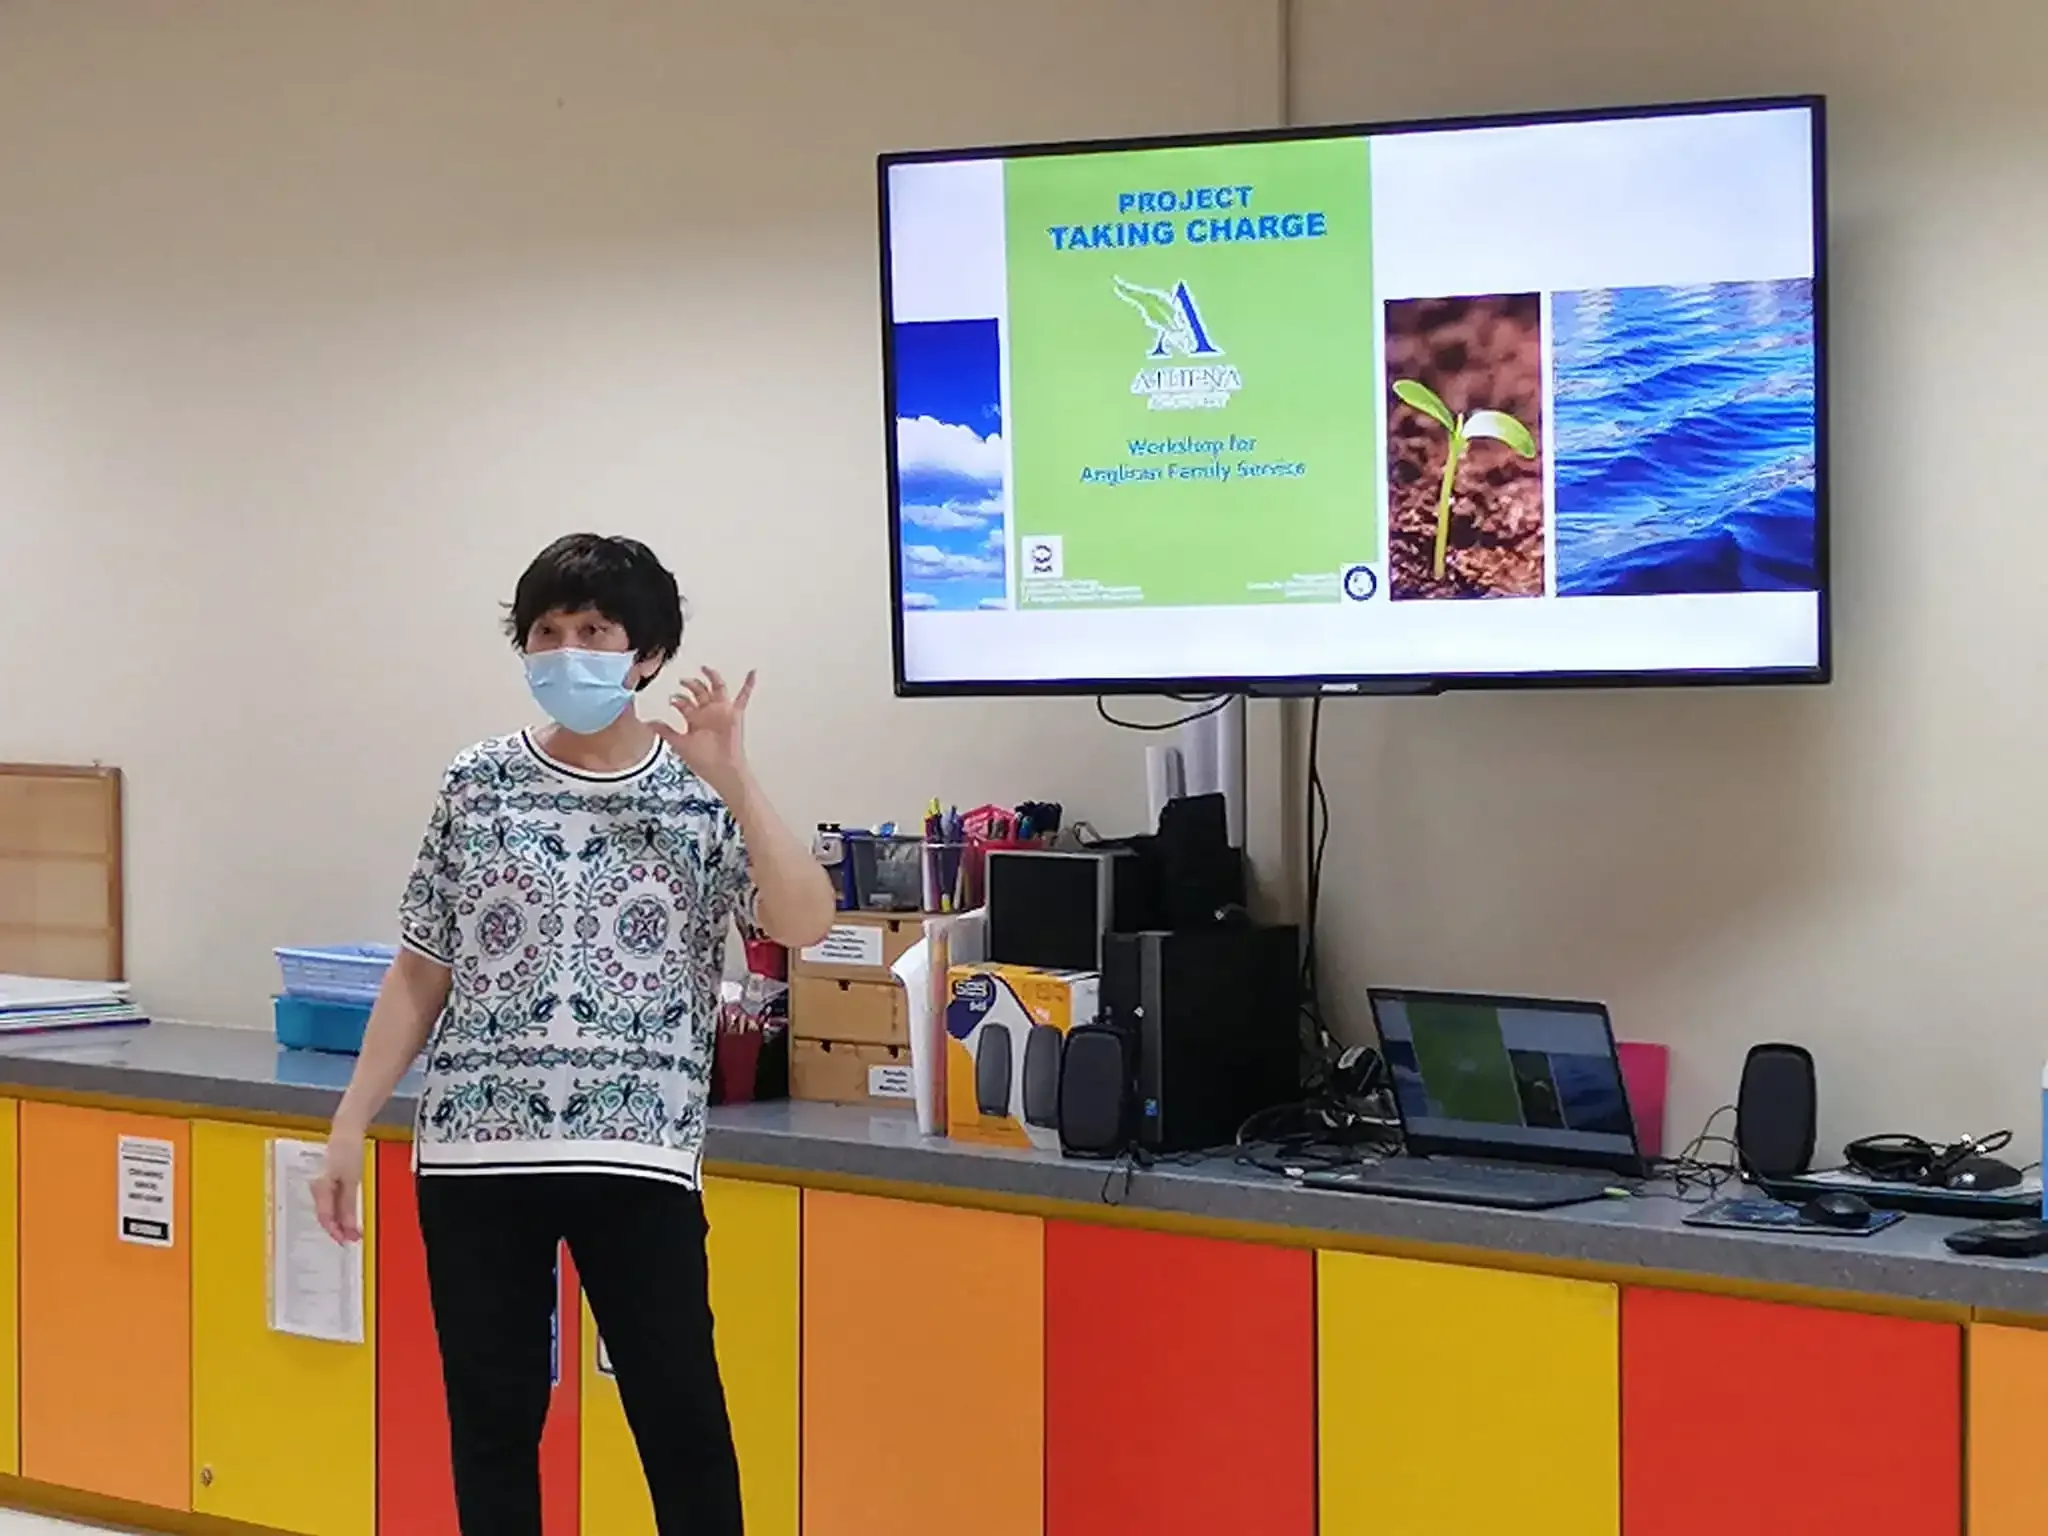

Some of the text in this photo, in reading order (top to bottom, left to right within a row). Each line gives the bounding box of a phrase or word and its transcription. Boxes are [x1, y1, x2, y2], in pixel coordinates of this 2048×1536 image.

[1118, 185, 1254, 213] PROJECT
[1049, 213, 1327, 250] TAKING CHARGE
[1128, 434, 1257, 457] Workshop for
[1168, 461, 1231, 482] Family
